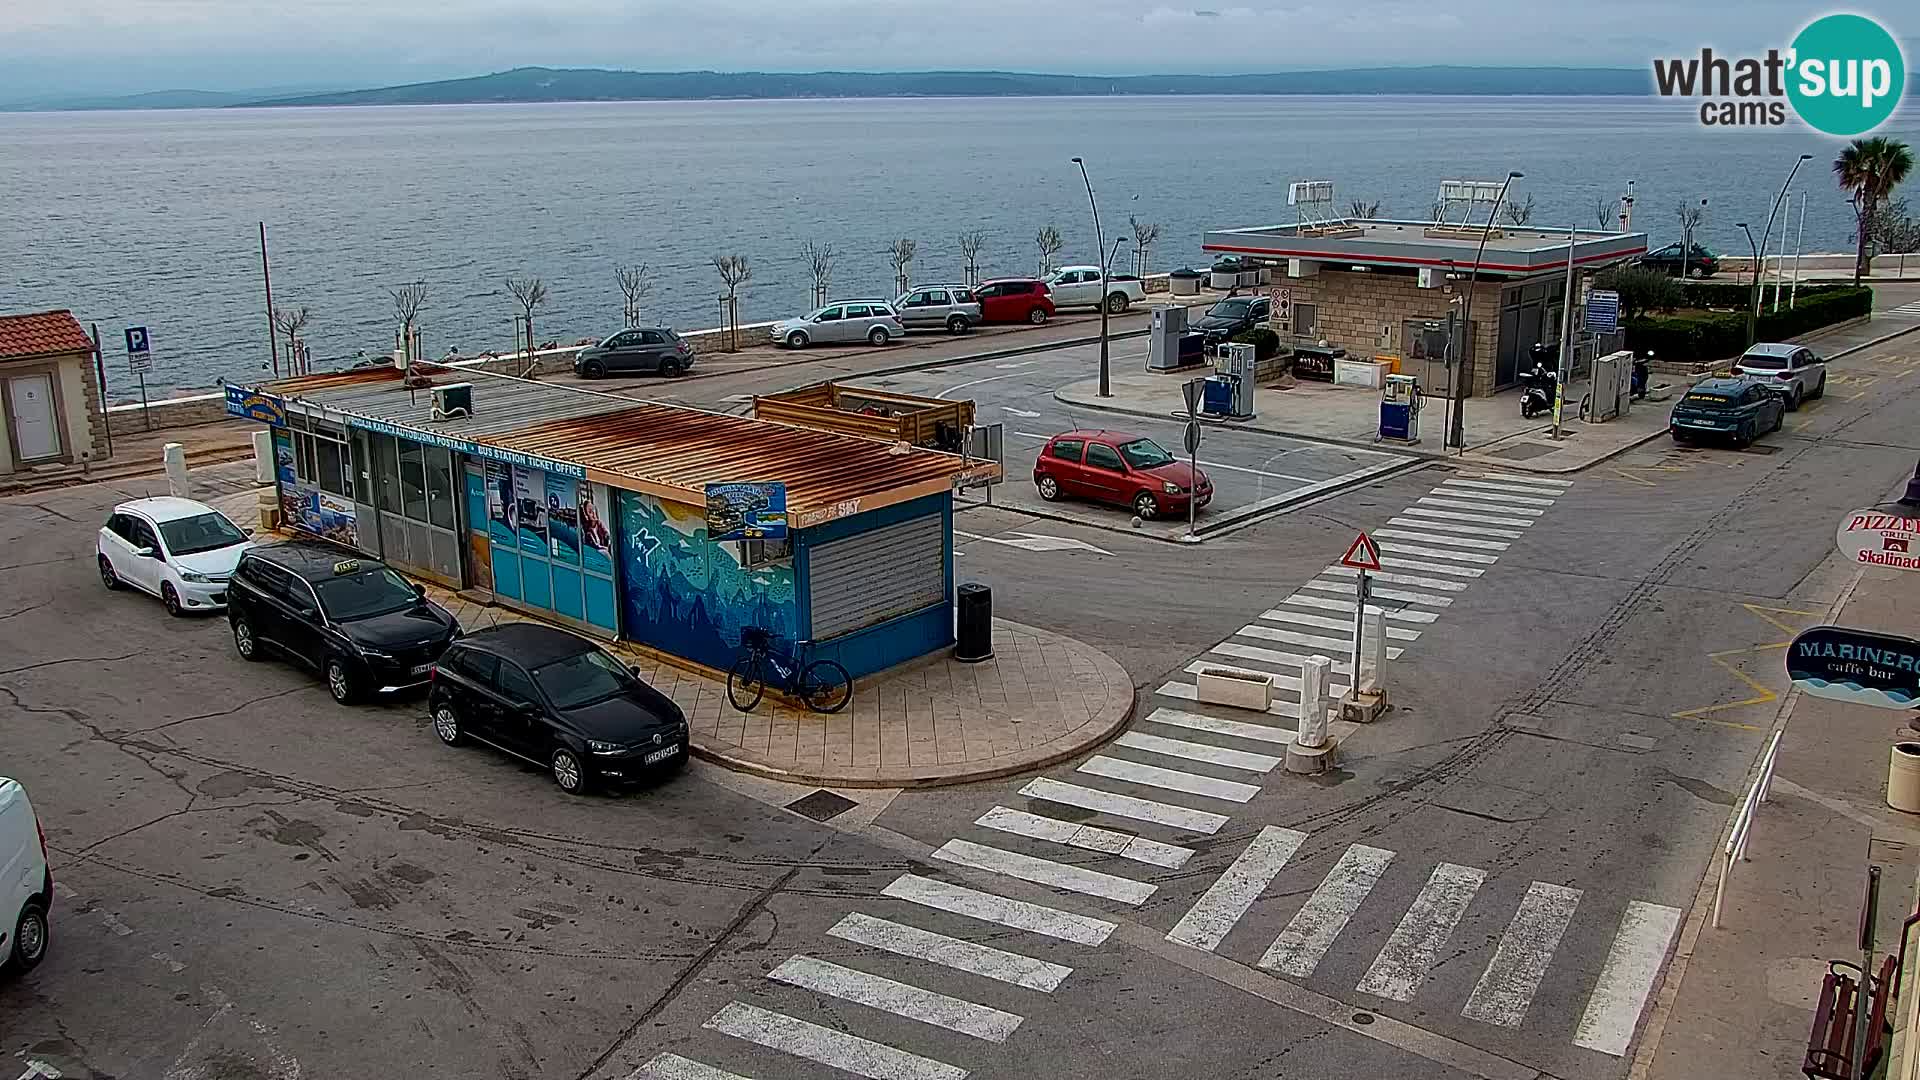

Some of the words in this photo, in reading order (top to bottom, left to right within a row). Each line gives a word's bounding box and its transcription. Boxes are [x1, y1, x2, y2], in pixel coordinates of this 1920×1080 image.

[130, 331, 143, 349] P
[396, 426, 436, 445] AUTOBUSNA
[436, 436, 468, 451] POSTAJA
[477, 446, 493, 457] BUS
[494, 449, 526, 465] STATION
[528, 456, 555, 470] TICKET
[555, 463, 582, 477] OFFICE
[1880, 530, 1915, 541] GRILL
[1868, 666, 1896, 680] bar
